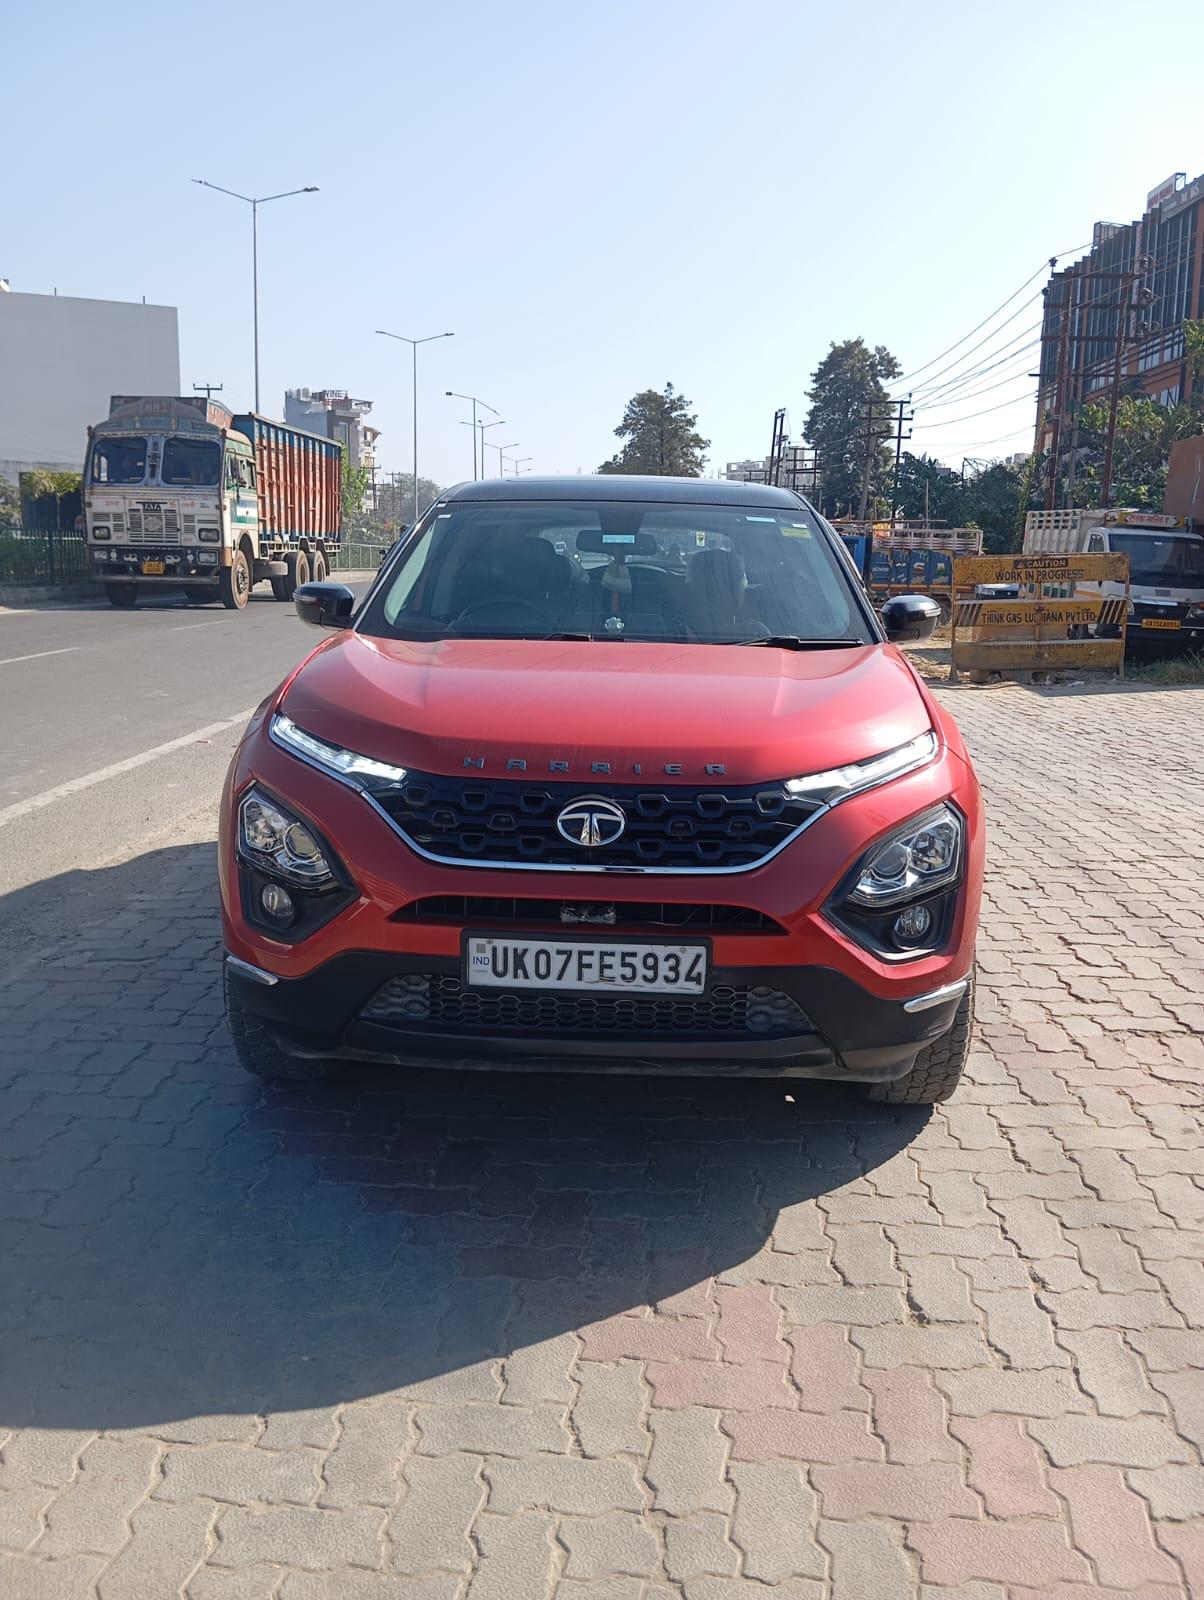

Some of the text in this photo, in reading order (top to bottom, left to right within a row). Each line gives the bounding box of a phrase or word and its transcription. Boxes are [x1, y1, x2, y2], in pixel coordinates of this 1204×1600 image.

[1026, 559, 1066, 568] CAUTION
[995, 568, 1085, 581] WORK IN PROGRESS
[981, 611, 1005, 624] THINK
[1006, 612, 1022, 623] GAS
[463, 757, 727, 775] HARRIER
[472, 955, 490, 966] IND
[491, 945, 703, 986] UK07FE5934
